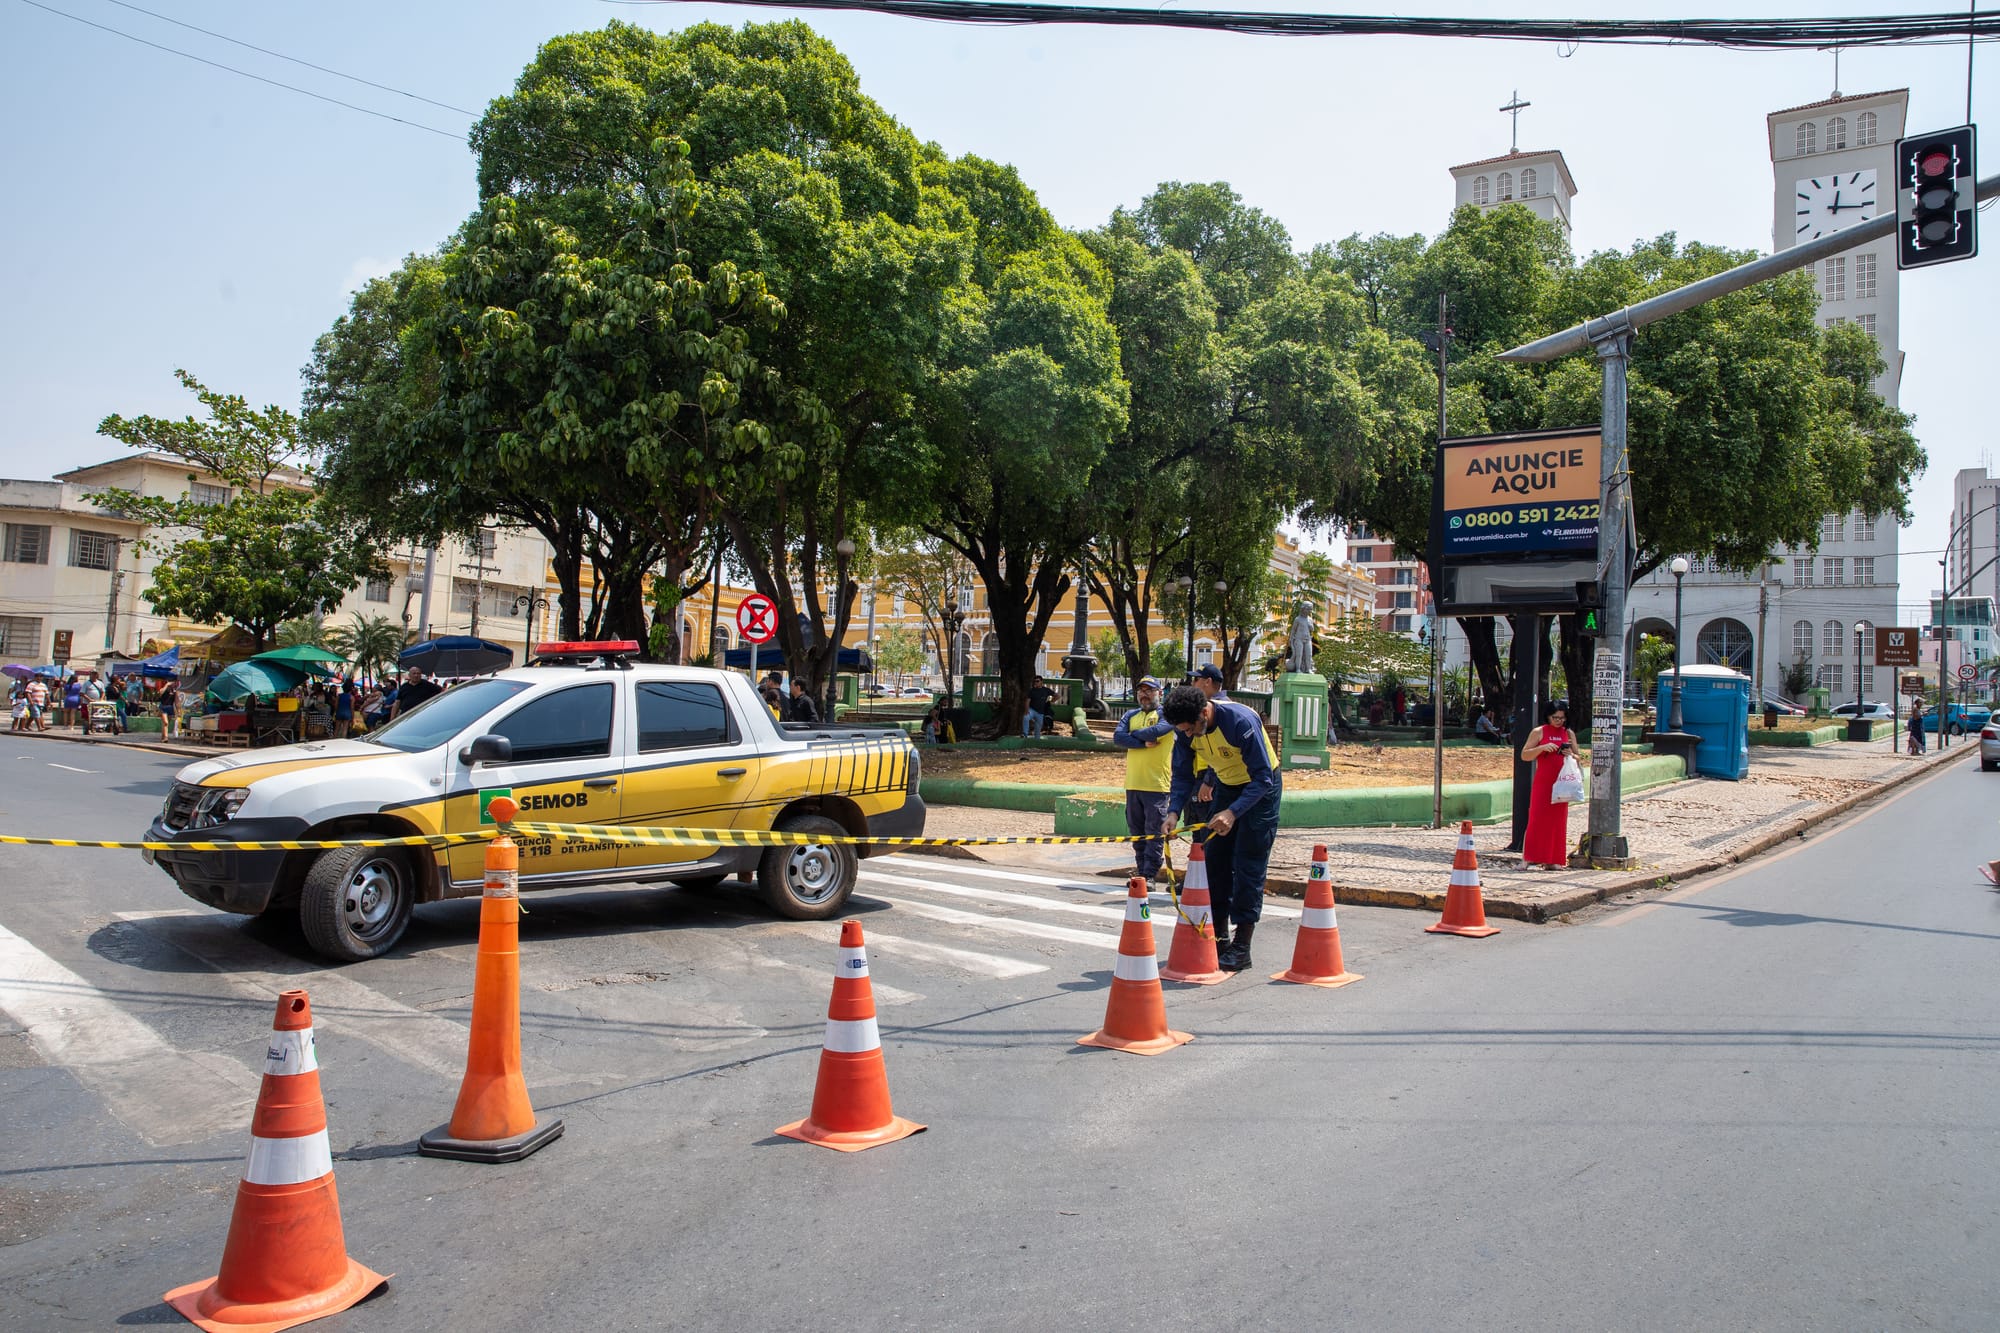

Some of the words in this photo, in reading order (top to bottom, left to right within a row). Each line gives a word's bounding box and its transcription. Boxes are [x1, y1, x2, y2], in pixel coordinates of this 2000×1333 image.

[1466, 449, 1584, 476] ANUNCIE
[1491, 472, 1556, 495] AQUI
[1465, 510, 1513, 528] 0800
[1518, 508, 1549, 524] 591
[1554, 504, 1600, 522] 2422
[1453, 532, 1529, 542] www.euromidia.com.br
[520, 792, 588, 811] SEMOB
[530, 845, 552, 857] 118
[562, 846, 574, 854] DE
